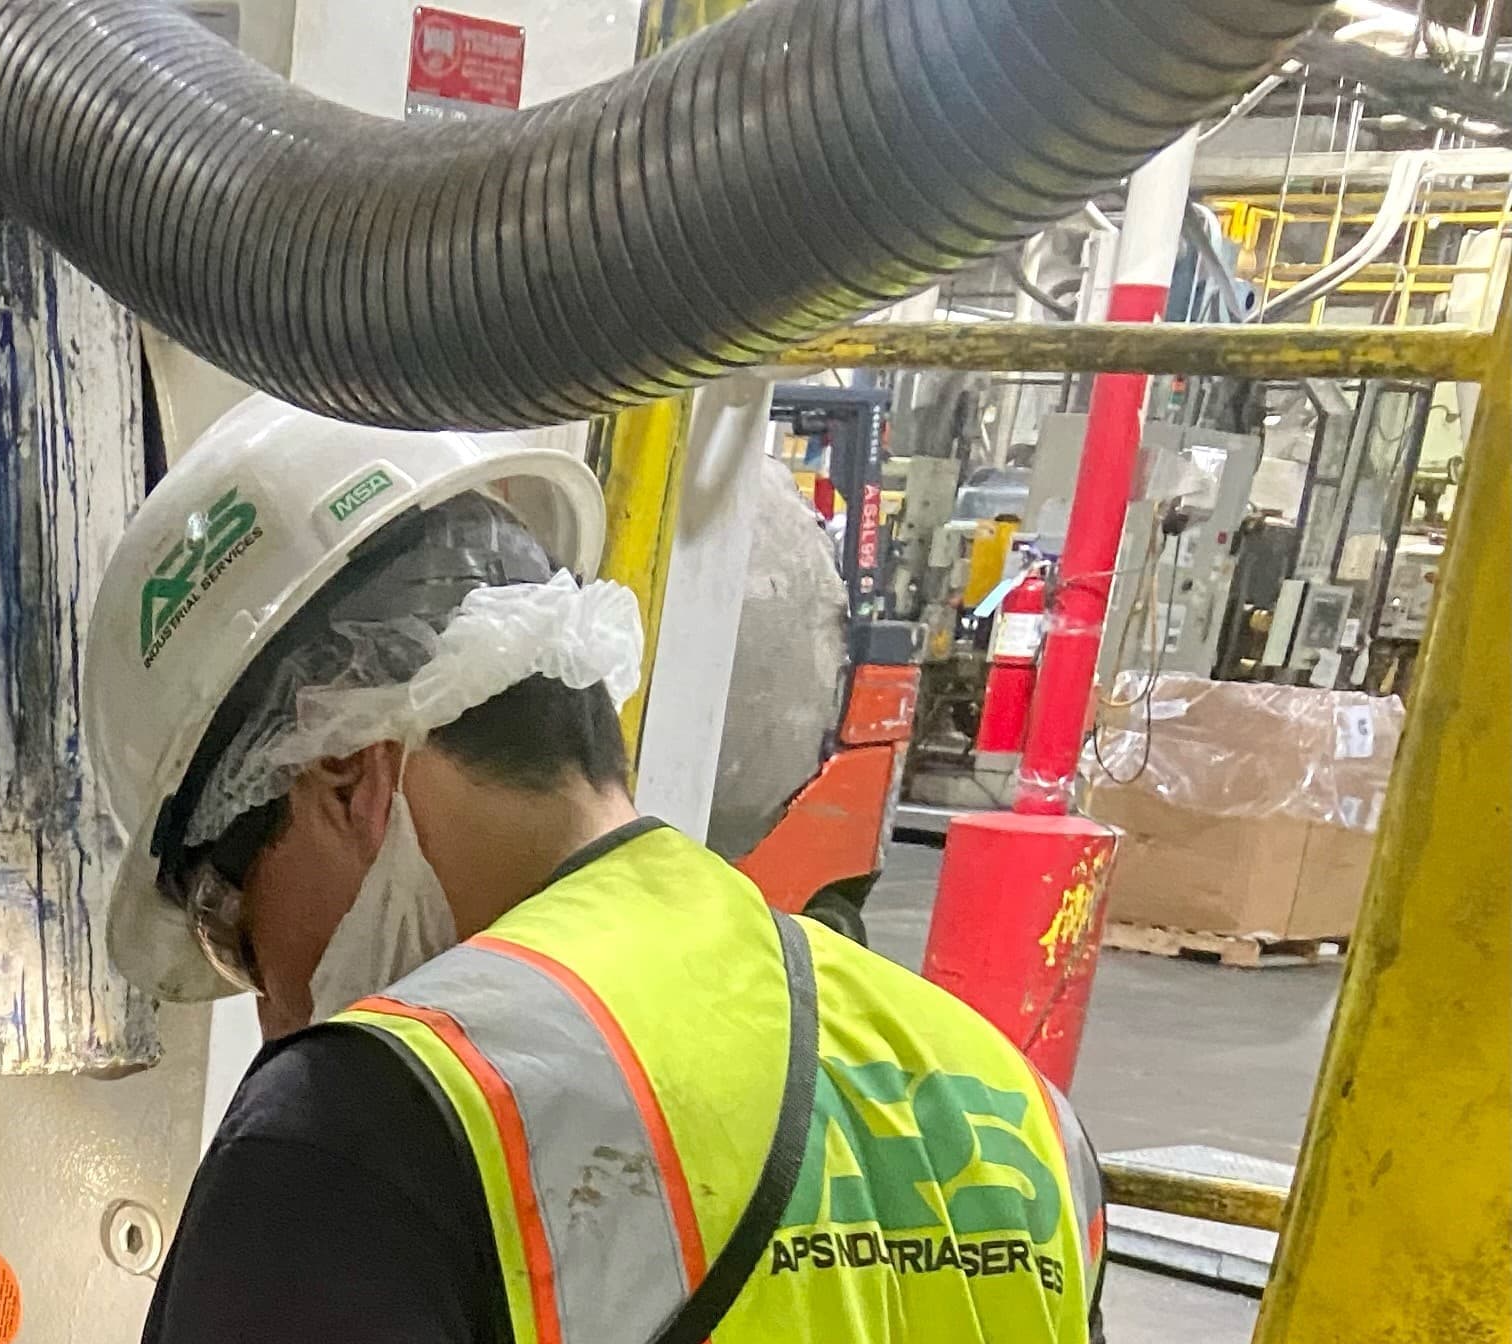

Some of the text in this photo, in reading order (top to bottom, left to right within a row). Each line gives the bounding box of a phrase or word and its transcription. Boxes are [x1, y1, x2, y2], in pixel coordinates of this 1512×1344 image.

[335, 474, 391, 518] MSA
[141, 486, 257, 657] APS
[143, 526, 264, 669] INDUSTRIAL SERVICES
[779, 1055, 1061, 1244] APS
[770, 1232, 835, 1275] APS
